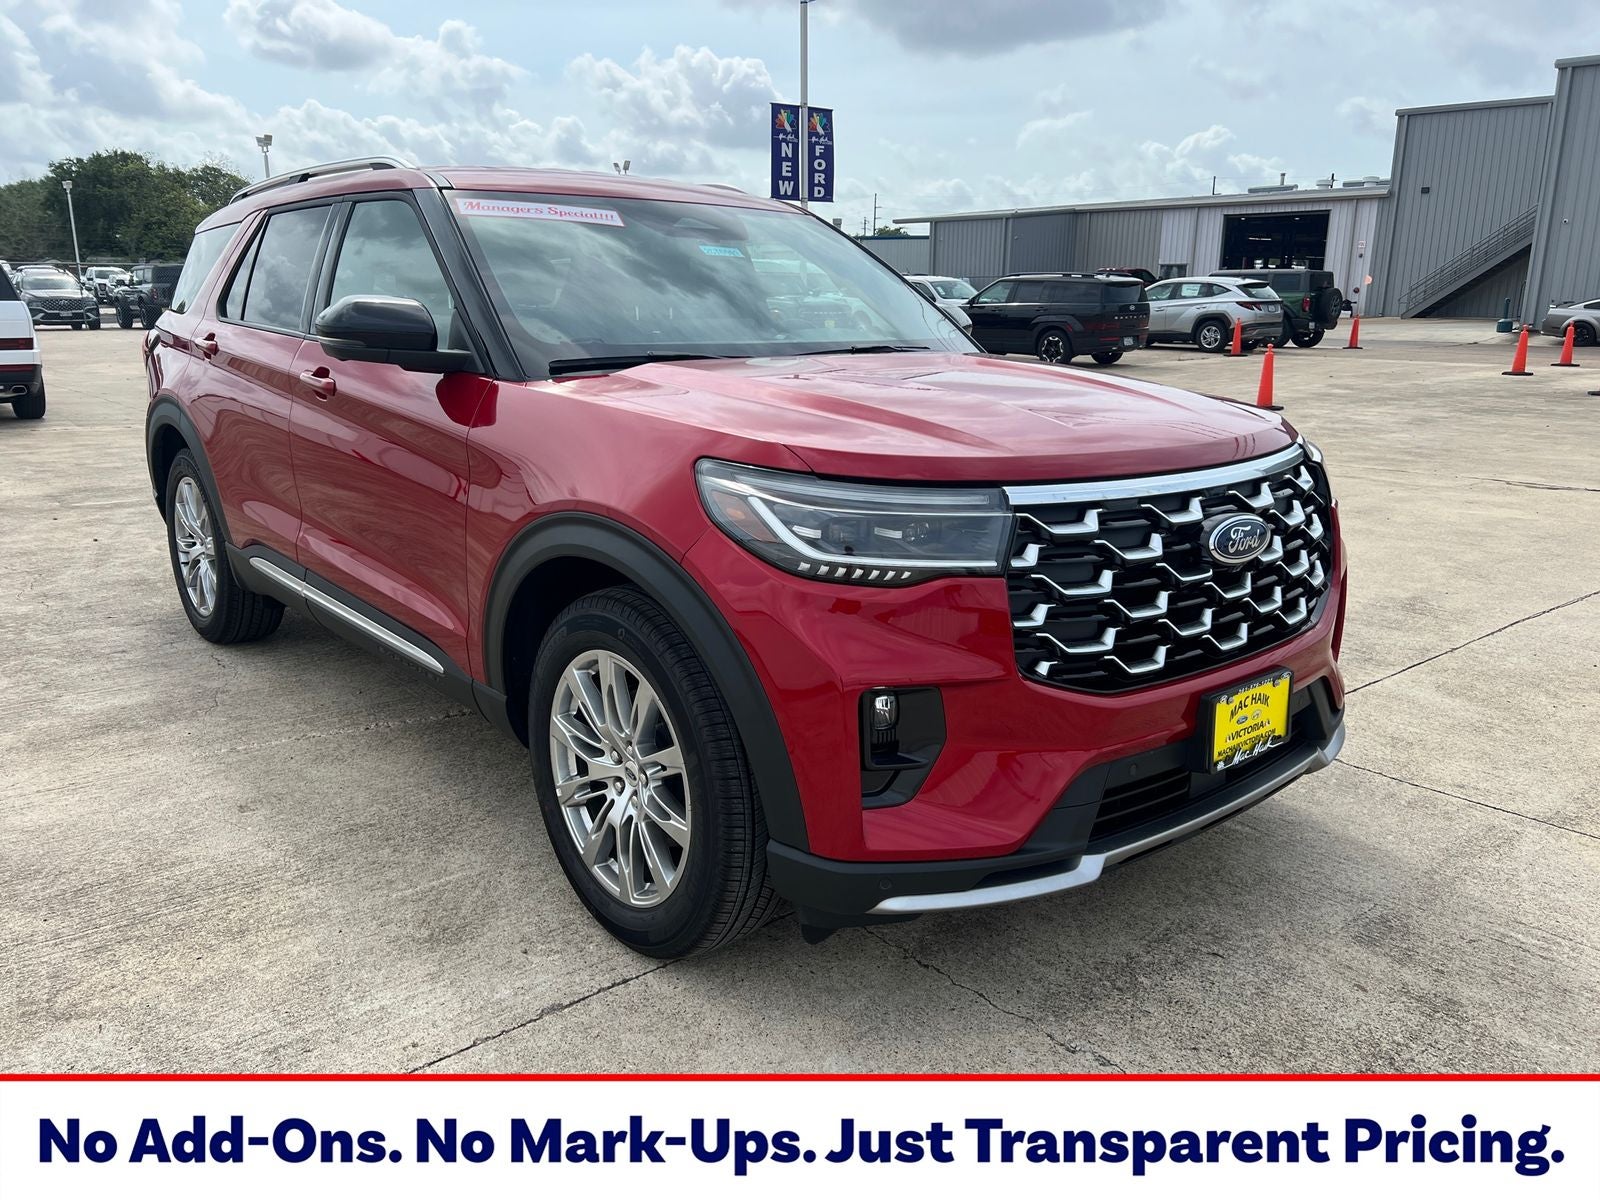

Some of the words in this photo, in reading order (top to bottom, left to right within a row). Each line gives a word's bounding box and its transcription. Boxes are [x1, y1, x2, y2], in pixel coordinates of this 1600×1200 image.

[778, 142, 795, 196] NEW
[813, 145, 826, 198] FORD
[1228, 525, 1261, 554] Ford
[1229, 696, 1250, 722] MAC
[1250, 692, 1270, 708] HAIK
[1231, 719, 1265, 742] VICTORIA
